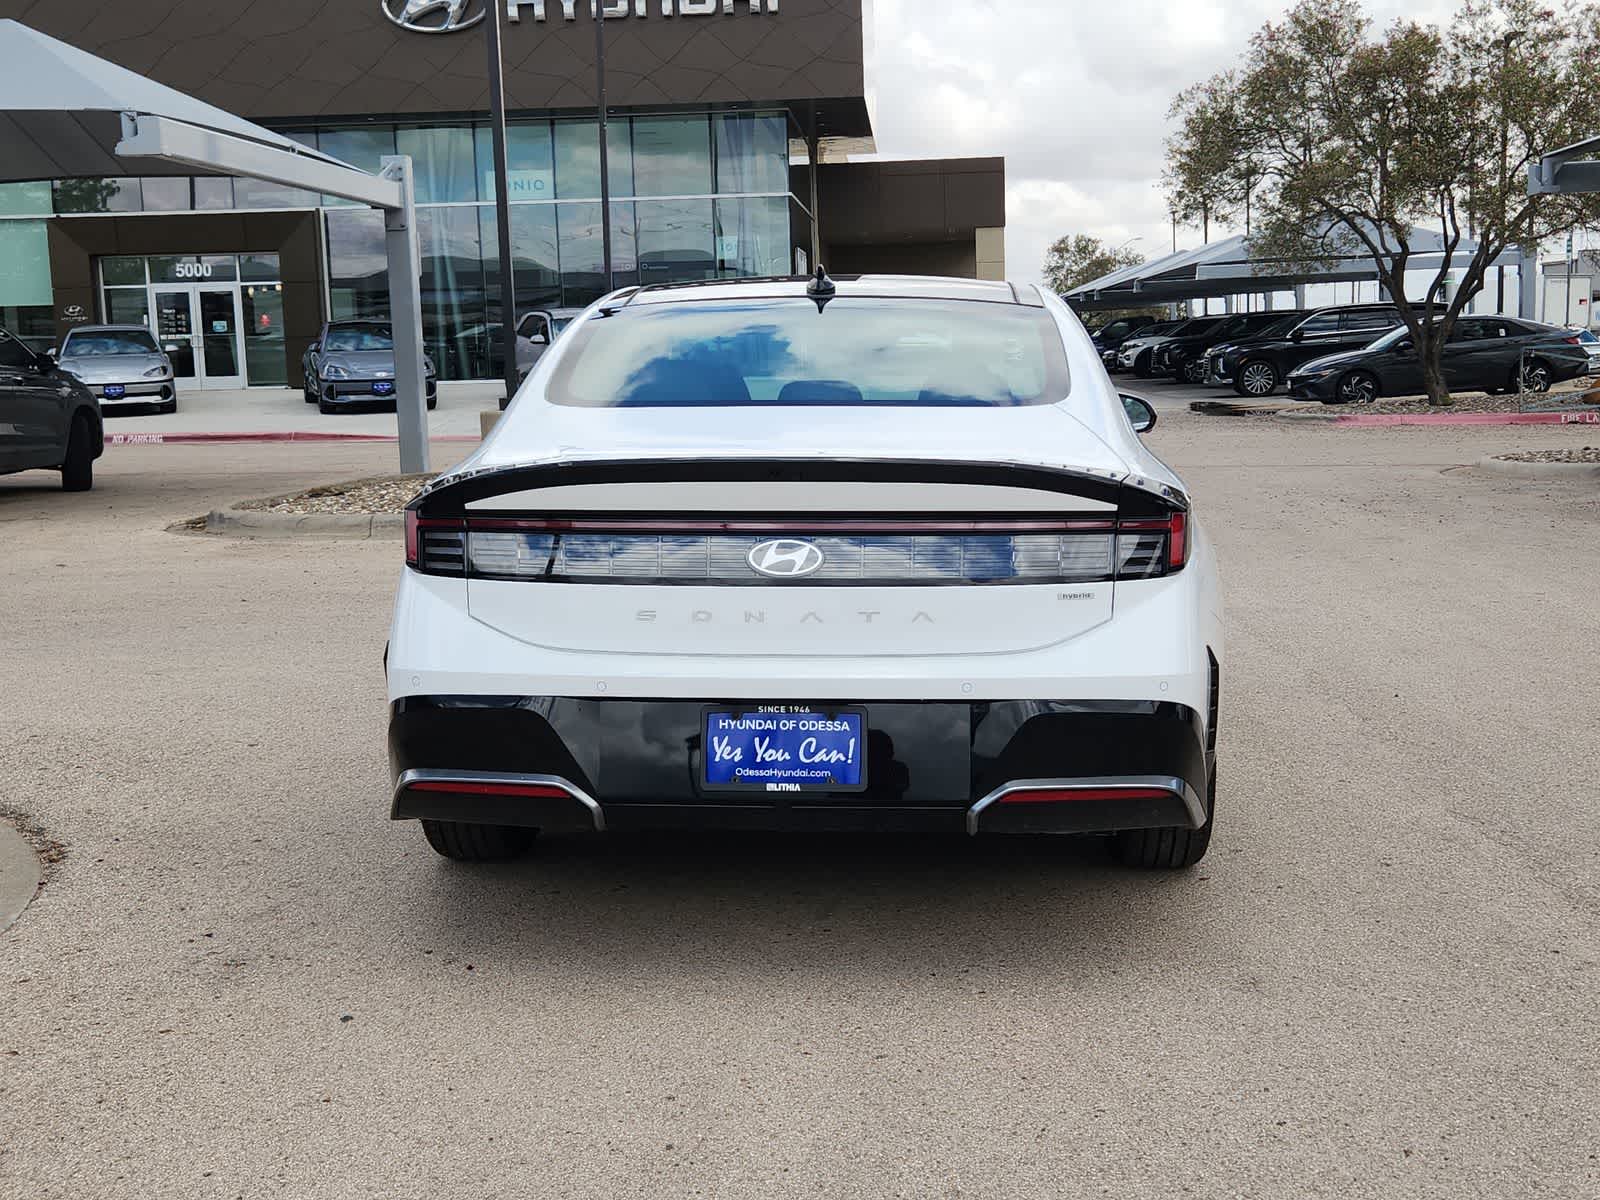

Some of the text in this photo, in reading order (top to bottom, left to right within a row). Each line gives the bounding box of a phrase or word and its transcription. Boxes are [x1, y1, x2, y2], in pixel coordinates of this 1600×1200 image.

[175, 263, 212, 278] 5000
[112, 434, 163, 444] NO PARKING
[635, 610, 935, 624] SONATA
[758, 705, 786, 713] SINCE
[719, 719, 850, 731] HYUNDAI OF ODESSA
[712, 735, 856, 764] Yes You Can!
[735, 767, 831, 778] OdessaHyundai.com
[774, 783, 801, 792] LITHIA
